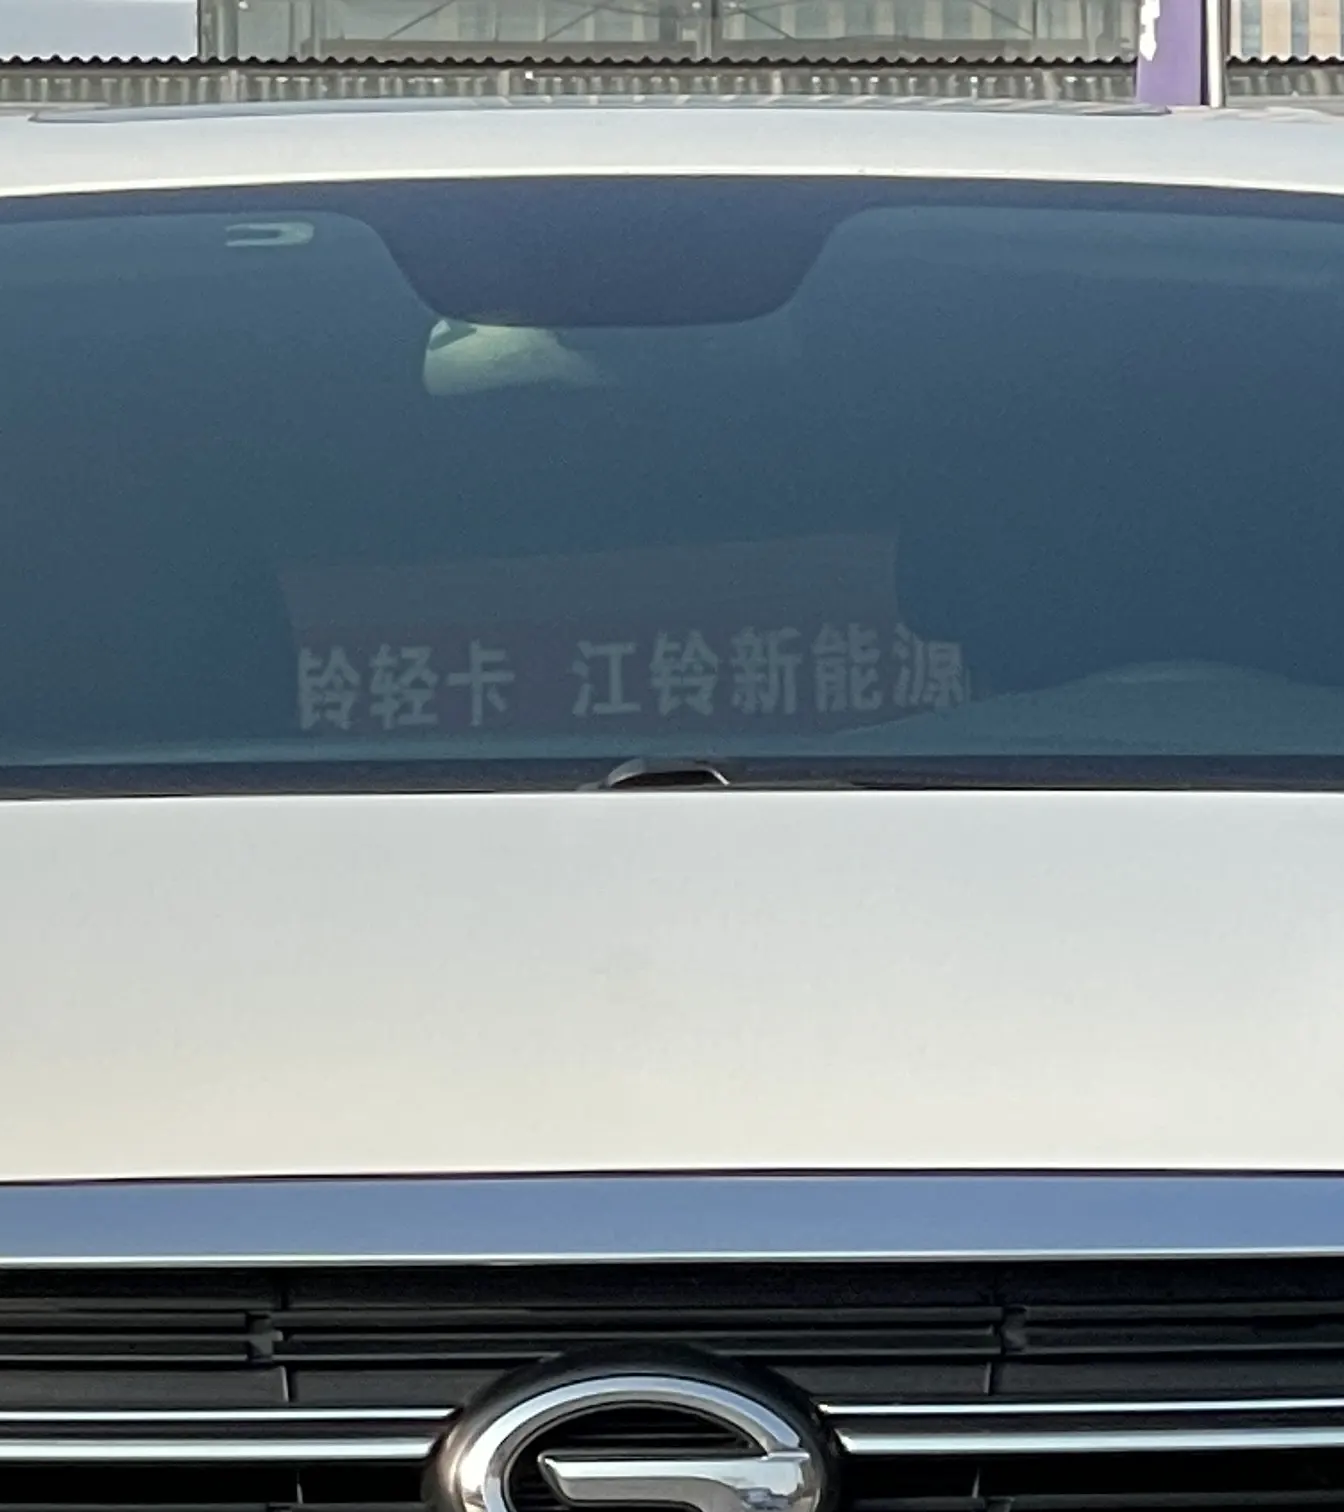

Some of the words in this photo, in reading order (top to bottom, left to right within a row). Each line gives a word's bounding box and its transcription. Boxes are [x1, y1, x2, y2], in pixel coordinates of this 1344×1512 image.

[571, 621, 962, 717] 江铃新能源
